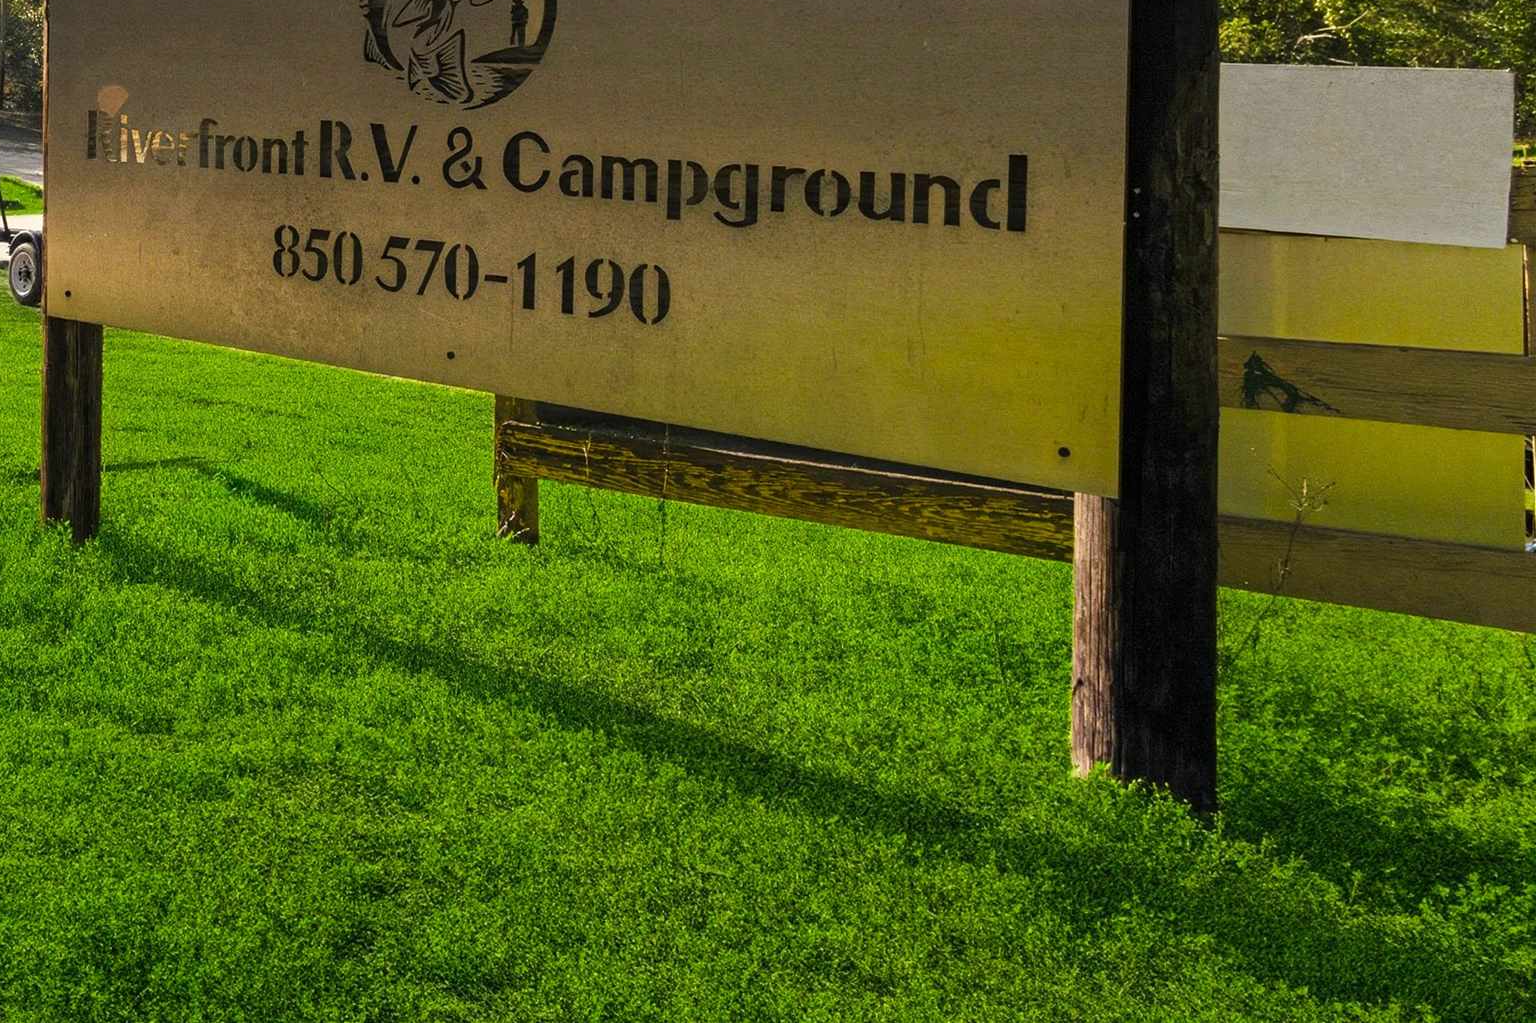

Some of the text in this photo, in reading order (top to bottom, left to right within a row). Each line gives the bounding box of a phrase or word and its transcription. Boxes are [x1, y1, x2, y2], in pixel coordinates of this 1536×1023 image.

[87, 110, 1029, 233] Riverfront R.V. & Campground
[272, 224, 671, 326] 850 570-1190
